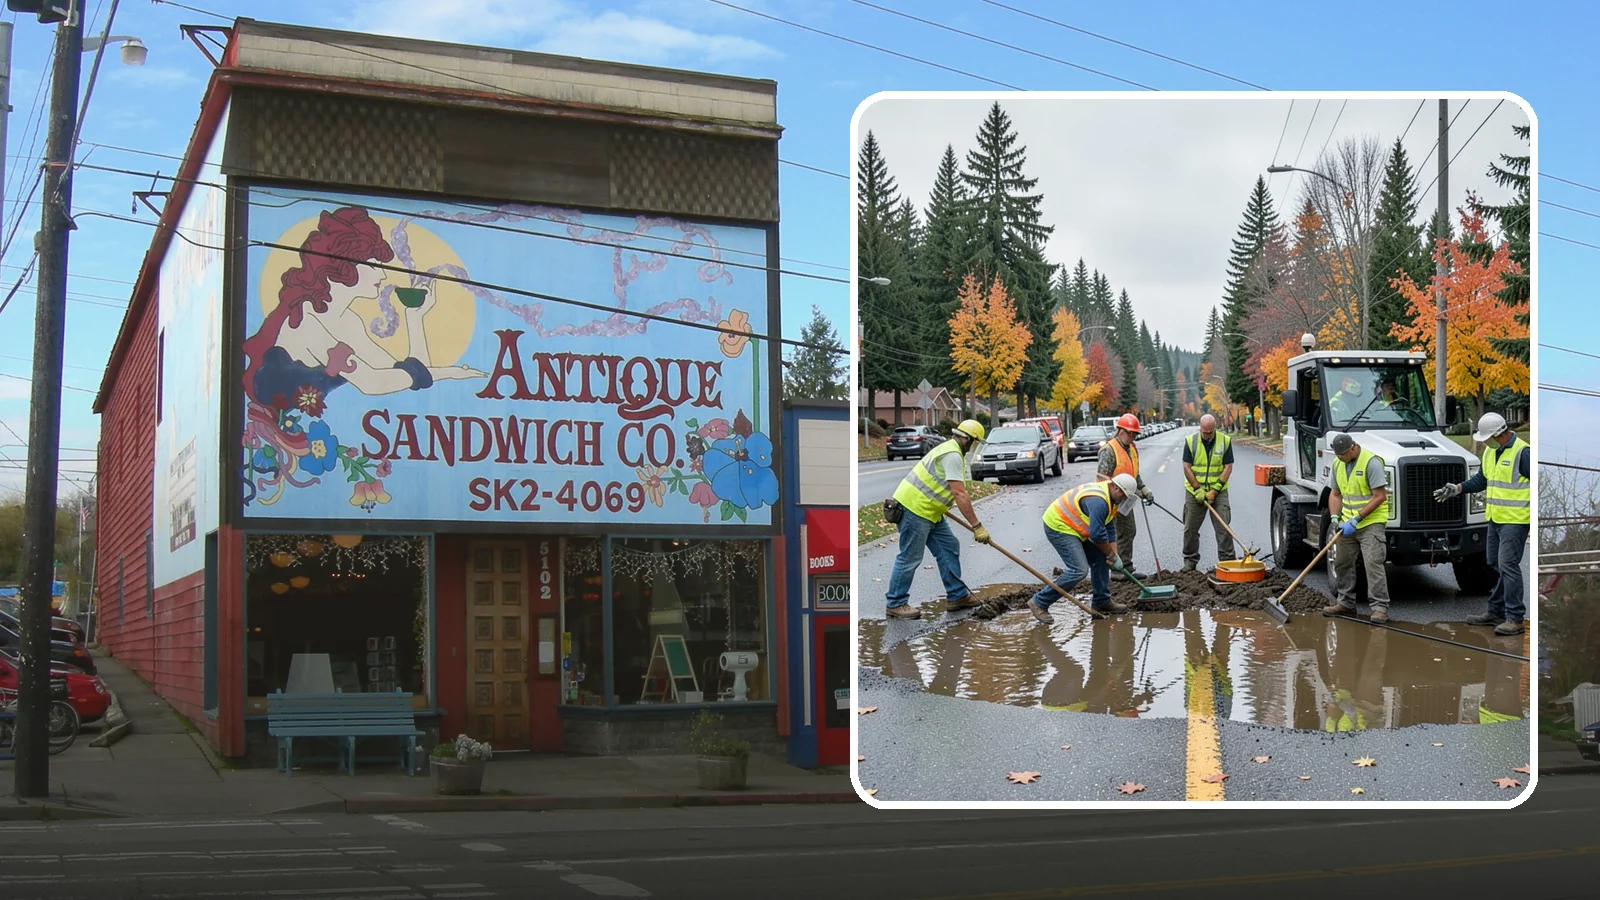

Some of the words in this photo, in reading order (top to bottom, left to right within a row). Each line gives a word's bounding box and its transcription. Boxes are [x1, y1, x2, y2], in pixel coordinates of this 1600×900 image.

[476, 329, 724, 420] ANTIQUE
[362, 408, 604, 467] SANDWICH
[617, 421, 685, 469] CO.
[468, 478, 647, 513] SK2-4069
[540, 542, 551, 599] 5102
[809, 555, 835, 569] BOOKS
